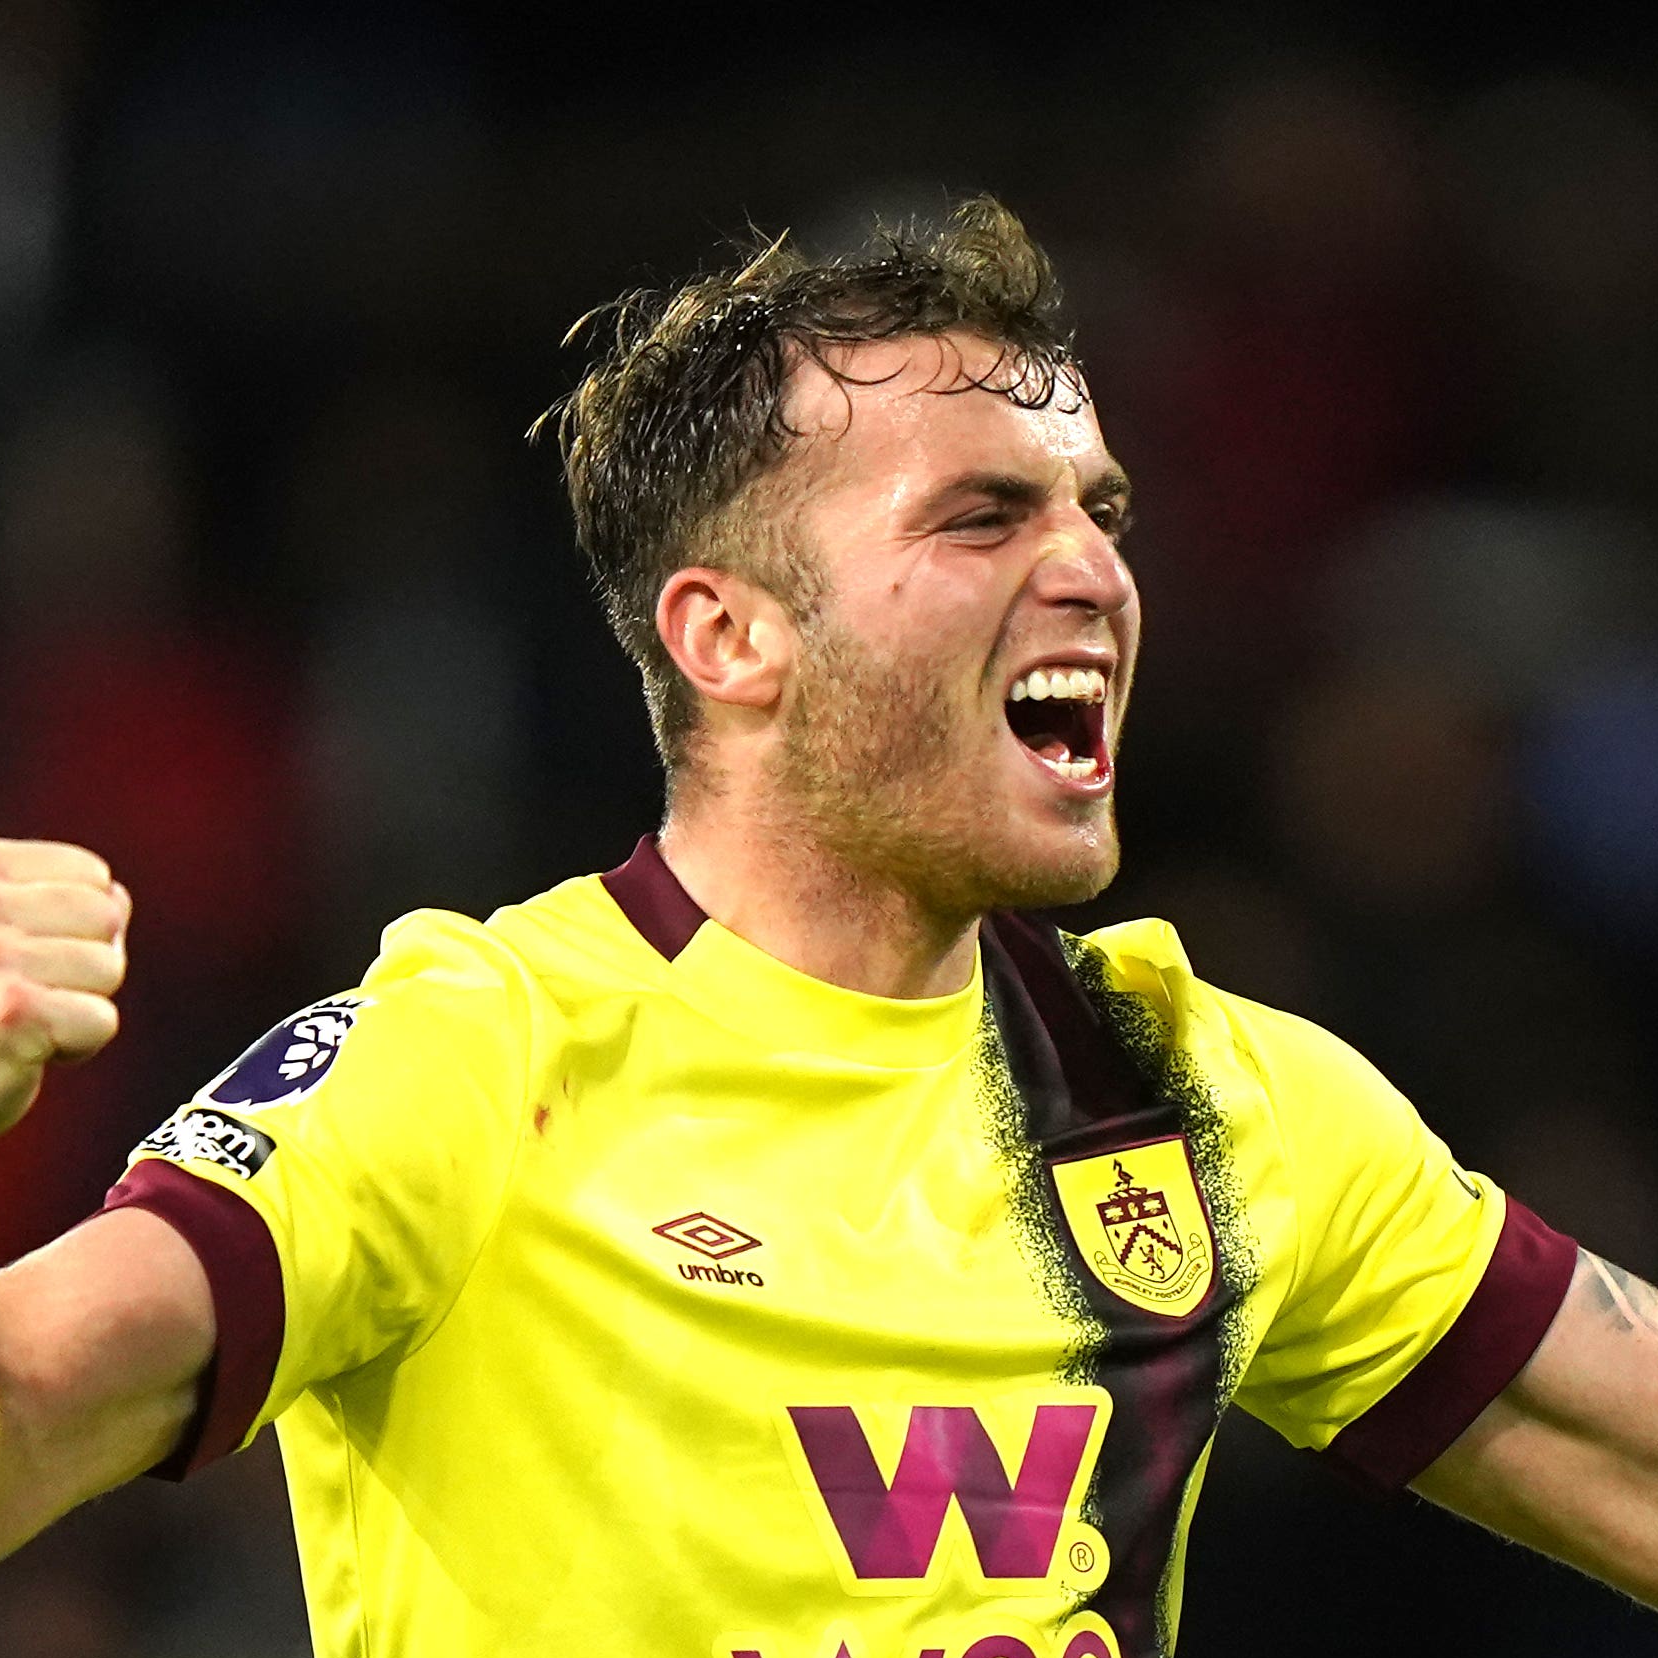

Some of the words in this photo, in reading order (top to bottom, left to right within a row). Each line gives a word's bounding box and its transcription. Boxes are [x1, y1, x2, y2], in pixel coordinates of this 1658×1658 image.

[678, 1264, 764, 1287] umbro
[1156, 1280, 1190, 1298] FOOTBALL
[1187, 1263, 1201, 1280] CLUB
[786, 1405, 1097, 1579] W
